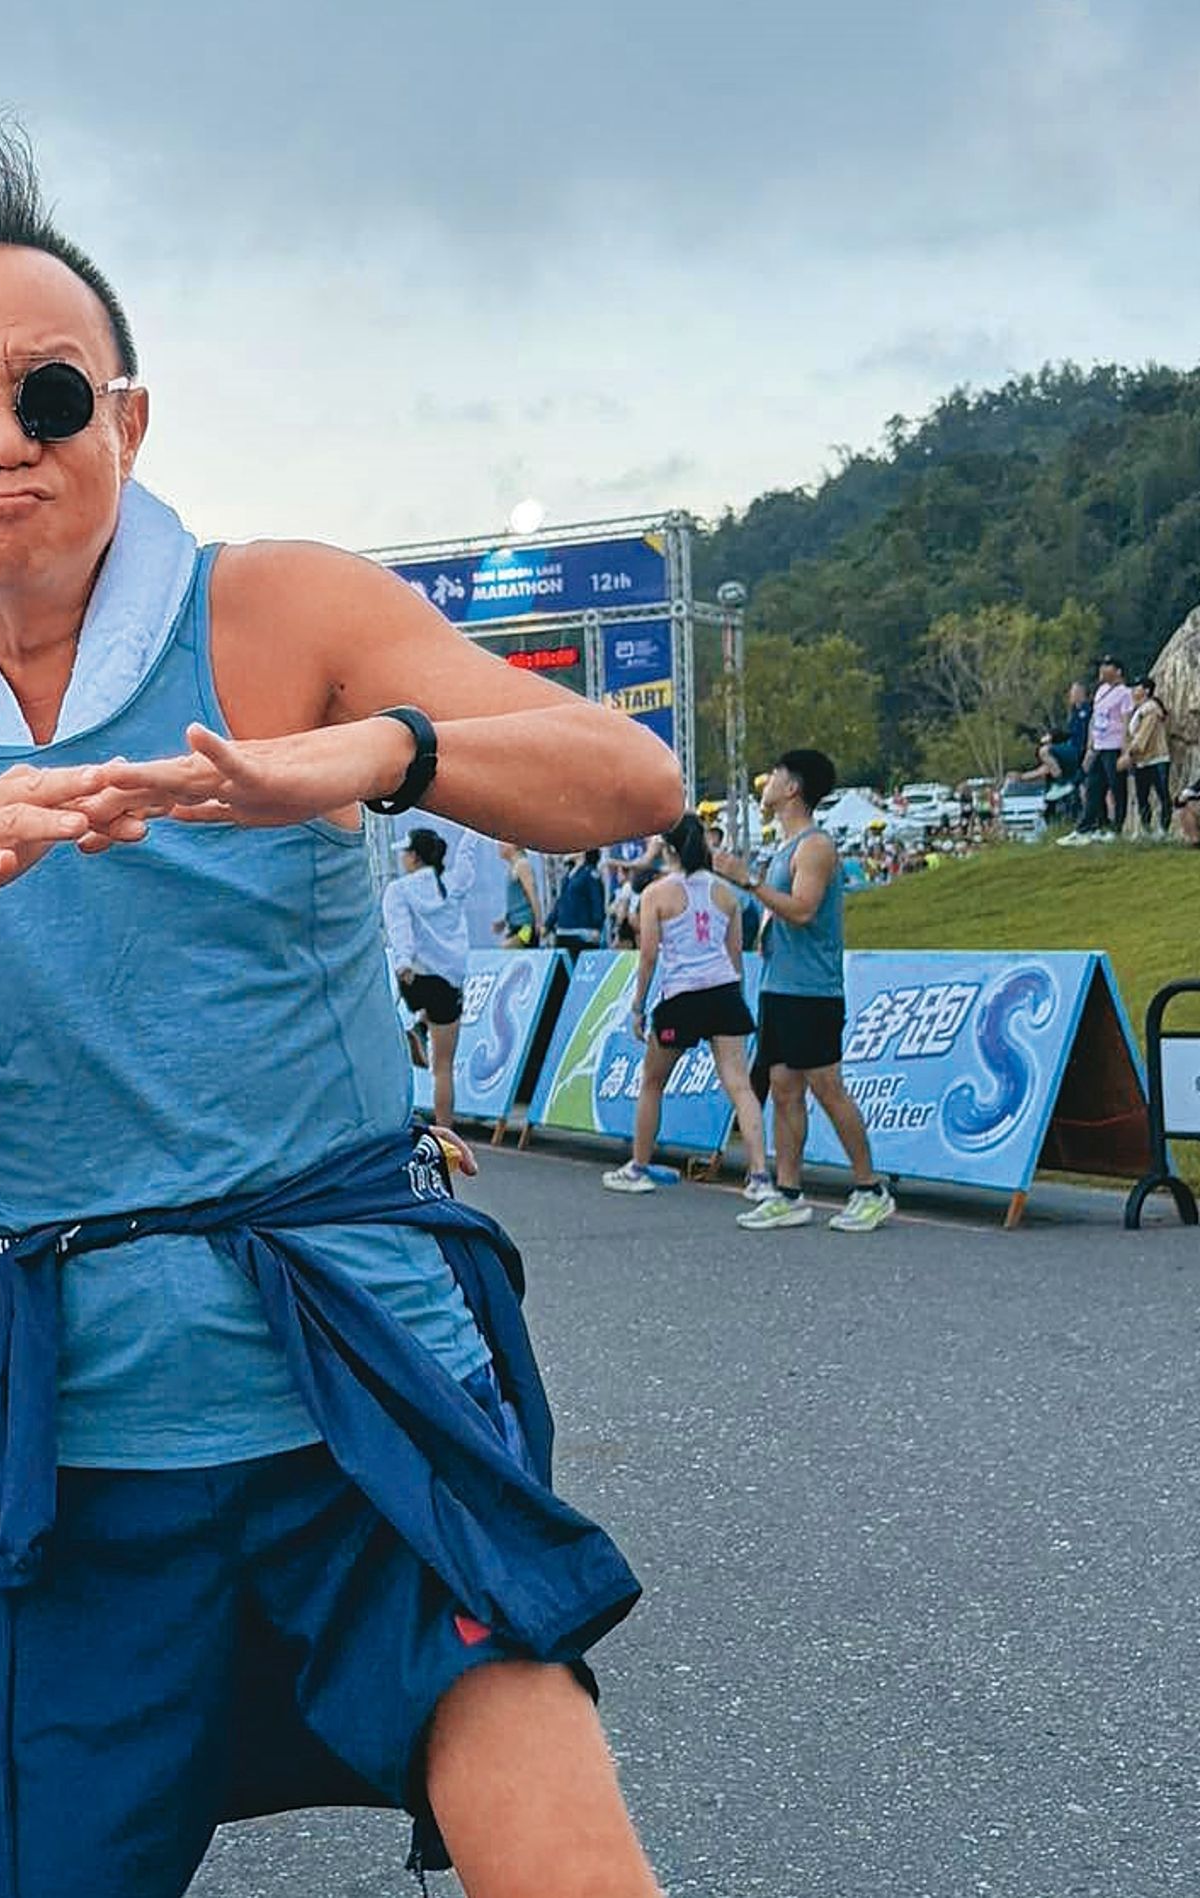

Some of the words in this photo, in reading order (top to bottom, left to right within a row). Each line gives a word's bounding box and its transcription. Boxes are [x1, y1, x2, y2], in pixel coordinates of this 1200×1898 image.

[472, 577, 564, 601] MARATHON
[590, 572, 632, 594] 12th
[611, 687, 668, 711] START
[842, 983, 980, 1062] 舒跑
[864, 1102, 934, 1130] Water
